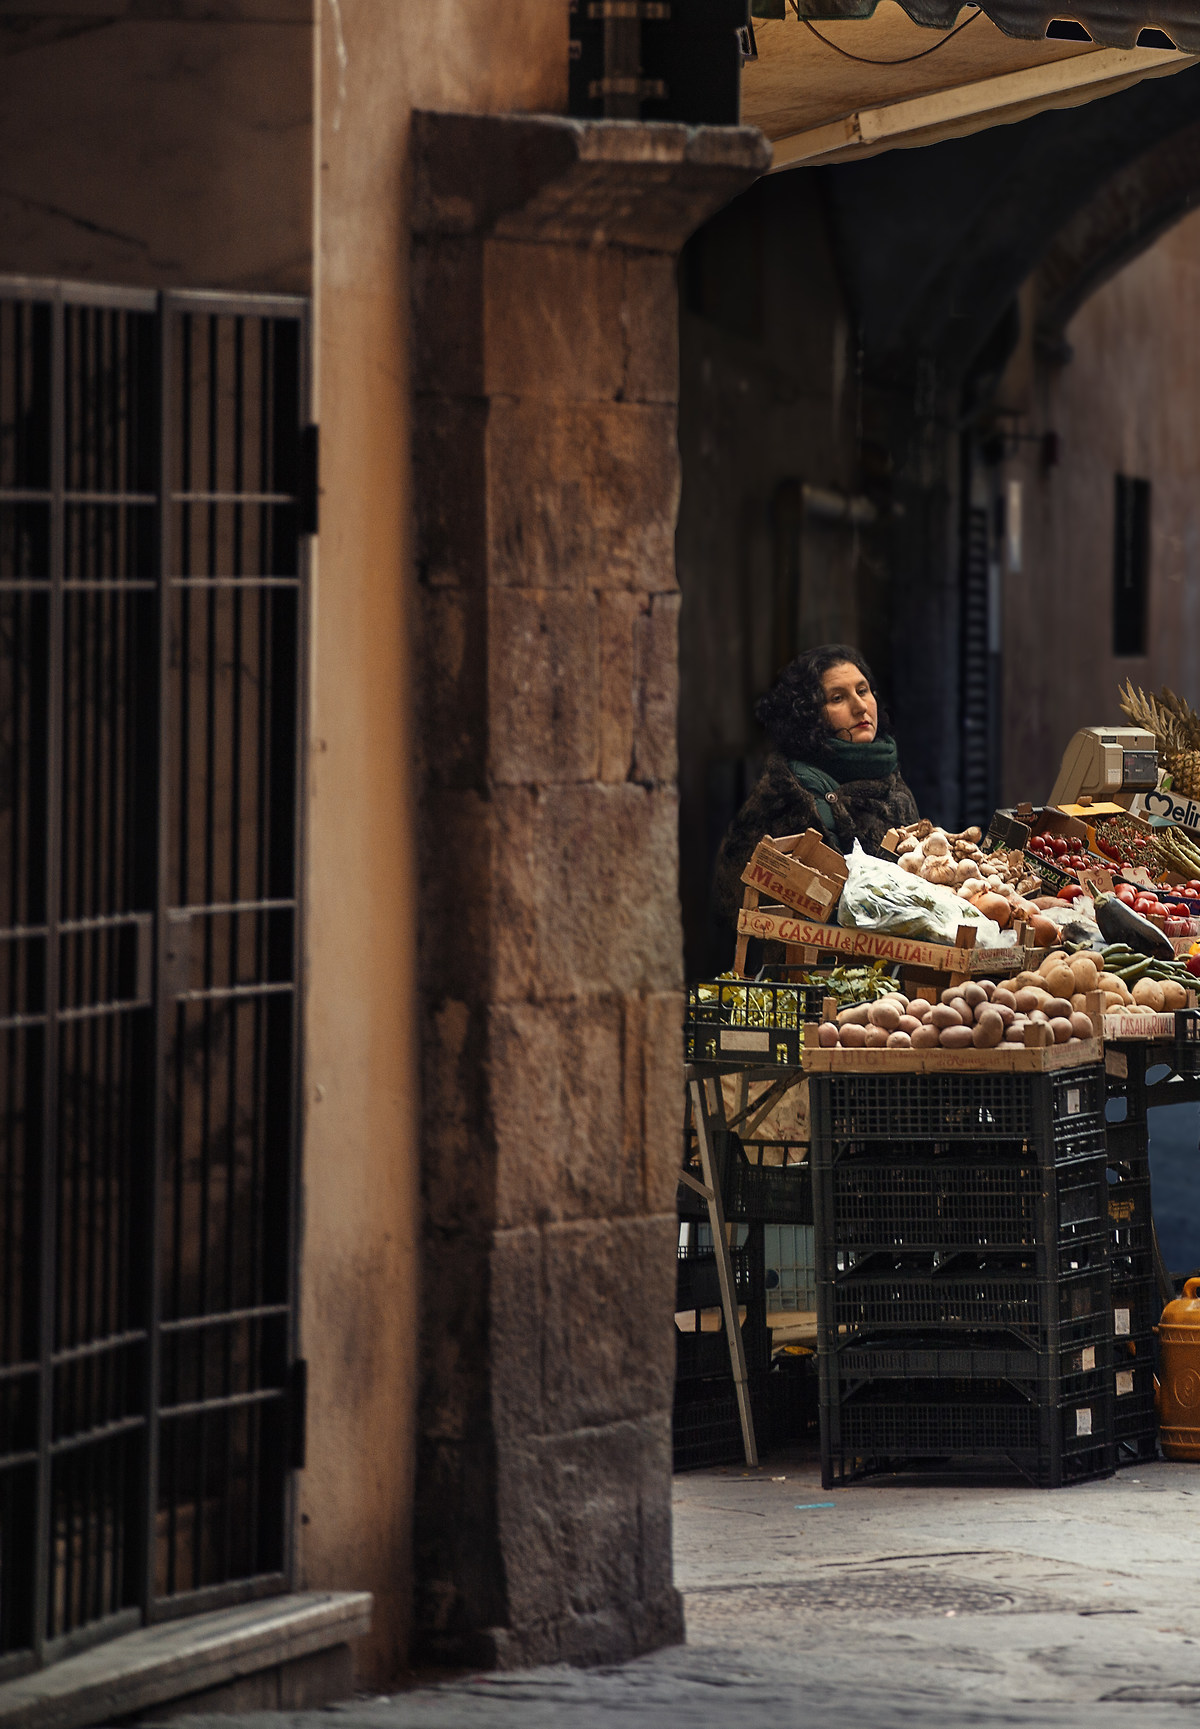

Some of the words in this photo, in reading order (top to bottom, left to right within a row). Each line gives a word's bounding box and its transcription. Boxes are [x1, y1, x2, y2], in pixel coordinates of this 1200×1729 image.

[749, 864, 824, 917] Magua
[778, 920, 840, 949] CASALI
[854, 932, 921, 963] RIVALTA
[1120, 1016, 1146, 1035] CASALI
[1151, 1015, 1175, 1034] RIVALT
